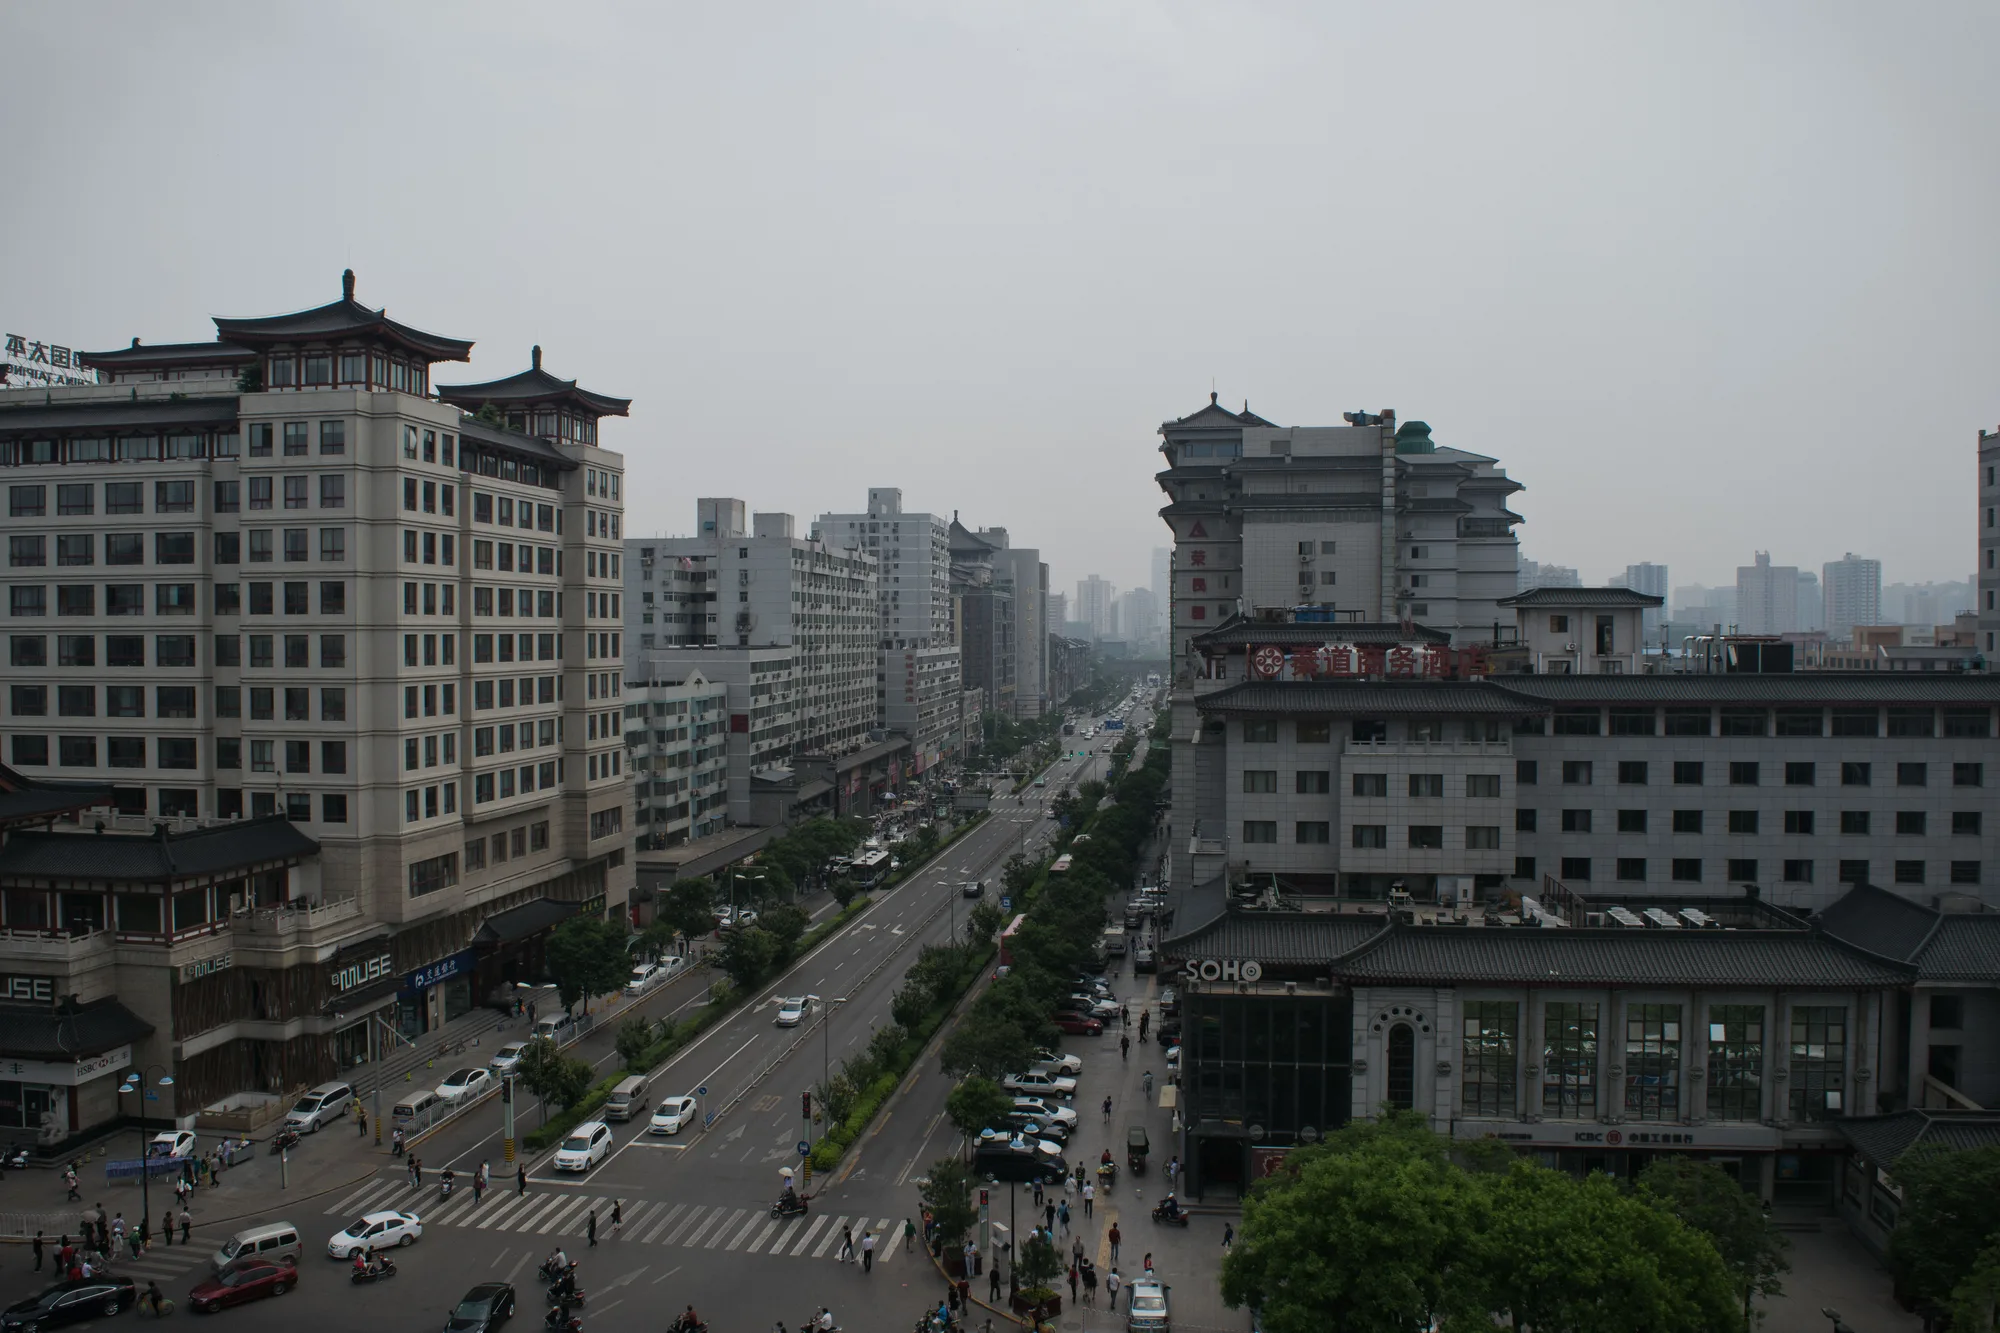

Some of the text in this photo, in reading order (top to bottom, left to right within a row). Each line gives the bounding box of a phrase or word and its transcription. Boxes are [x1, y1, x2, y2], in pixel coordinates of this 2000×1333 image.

[340, 954, 391, 992] MUSE
[1185, 959, 1262, 982] SOHO
[76, 1051, 129, 1077] HSBC 汇丰
[1575, 1132, 1603, 1142] ICBC
